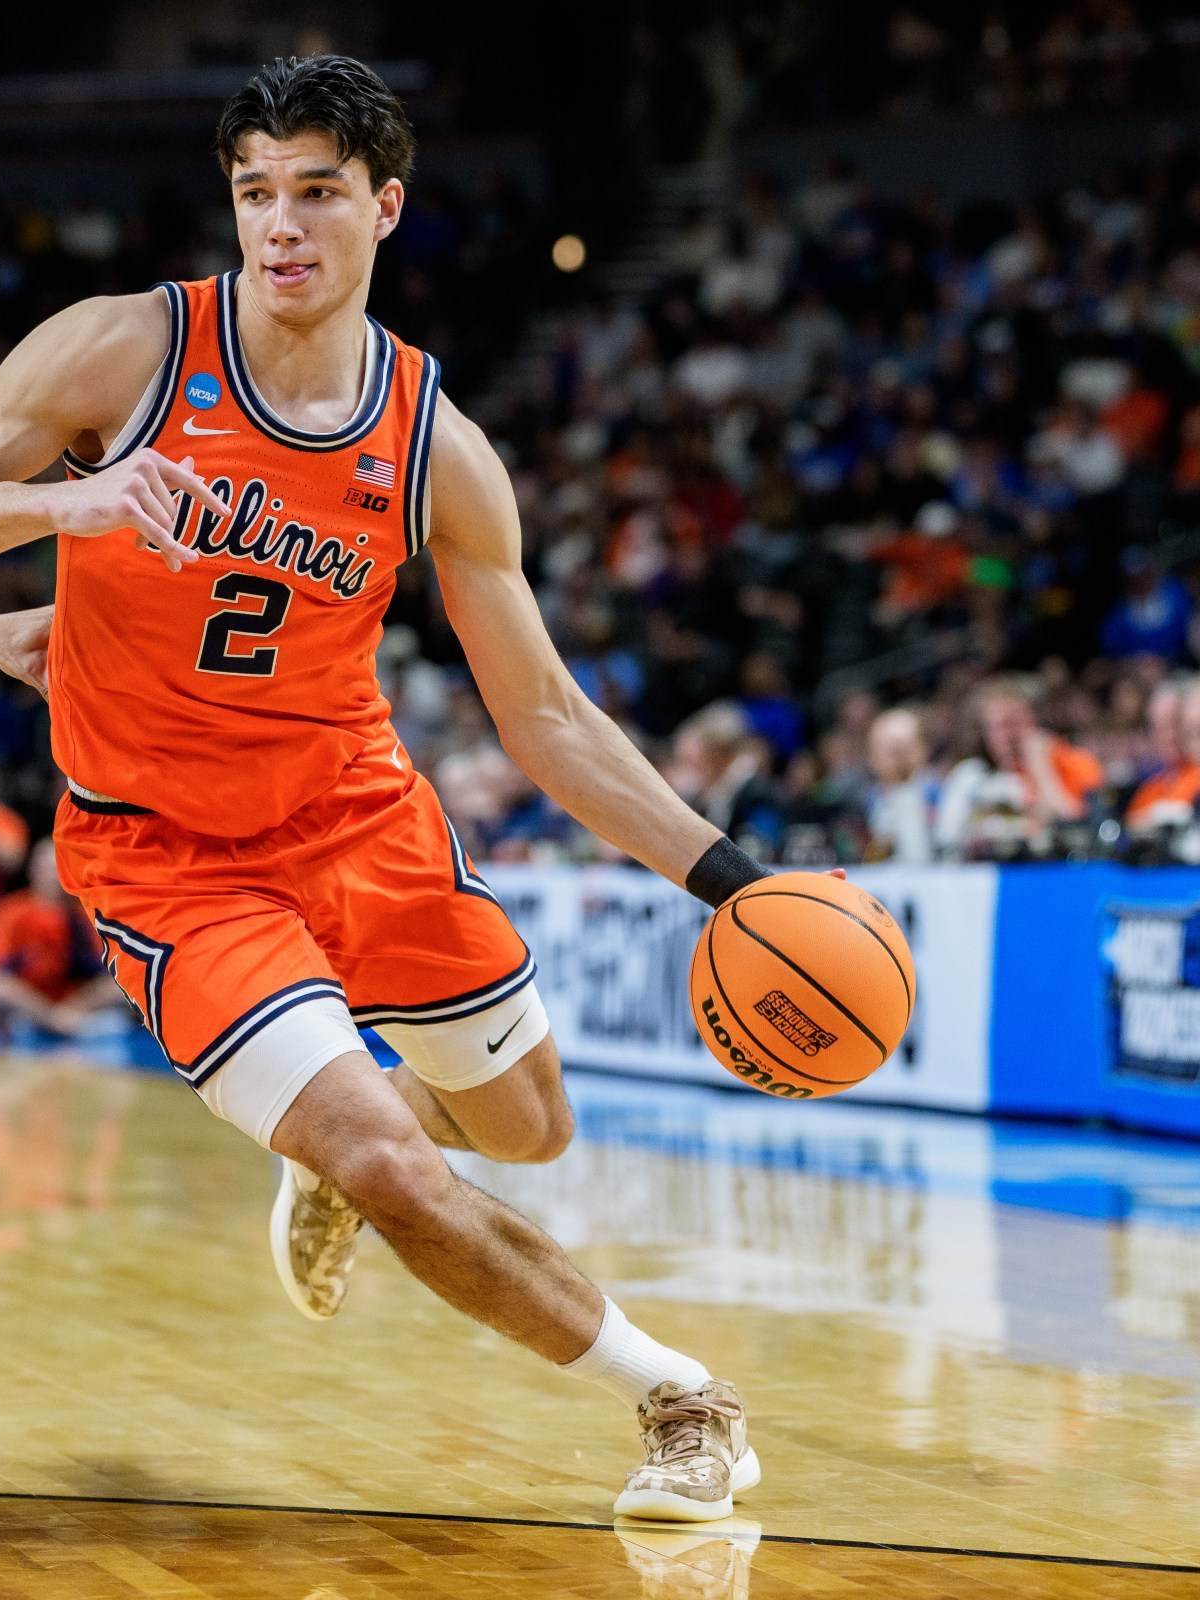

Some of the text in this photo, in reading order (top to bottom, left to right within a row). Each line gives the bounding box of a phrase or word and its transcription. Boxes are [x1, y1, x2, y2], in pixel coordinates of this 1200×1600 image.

[188, 386, 218, 404] NCAA
[195, 571, 294, 678] 2
[766, 991, 816, 1038] MADNESS
[771, 1014, 811, 1049] MARCH
[701, 993, 814, 1099] Wilson
[736, 1040, 774, 1074] EVO NXT
